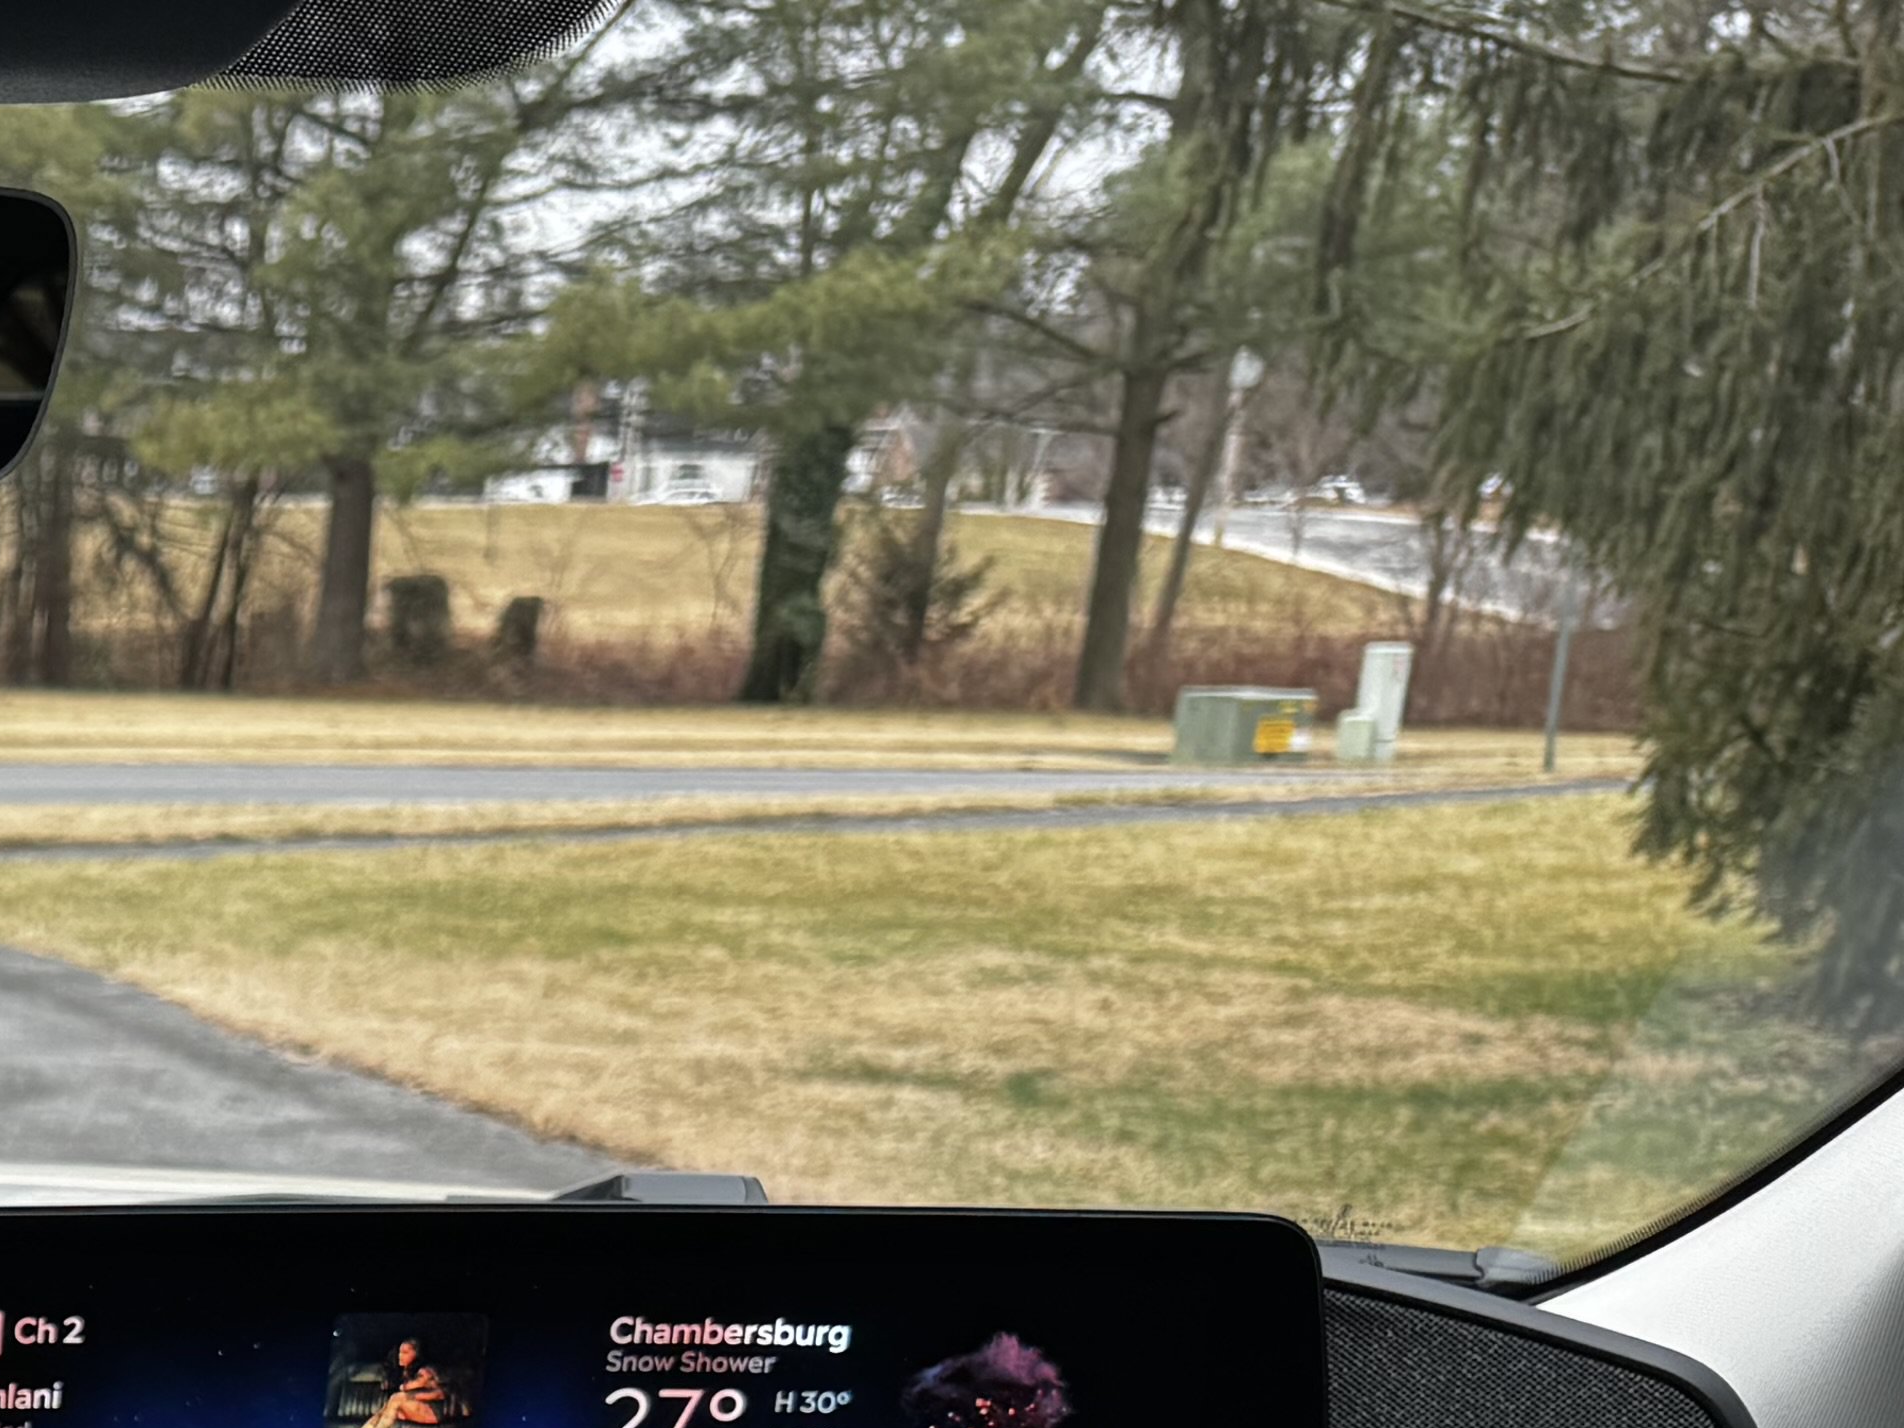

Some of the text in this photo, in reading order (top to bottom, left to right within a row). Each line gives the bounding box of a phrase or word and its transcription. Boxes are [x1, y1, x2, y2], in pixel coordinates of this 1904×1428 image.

[14, 1316, 85, 1344] Ch 2
[609, 1315, 852, 1353] Chambersburg
[605, 1350, 778, 1374] Snow Shower
[774, 1390, 853, 1414] H 30°
